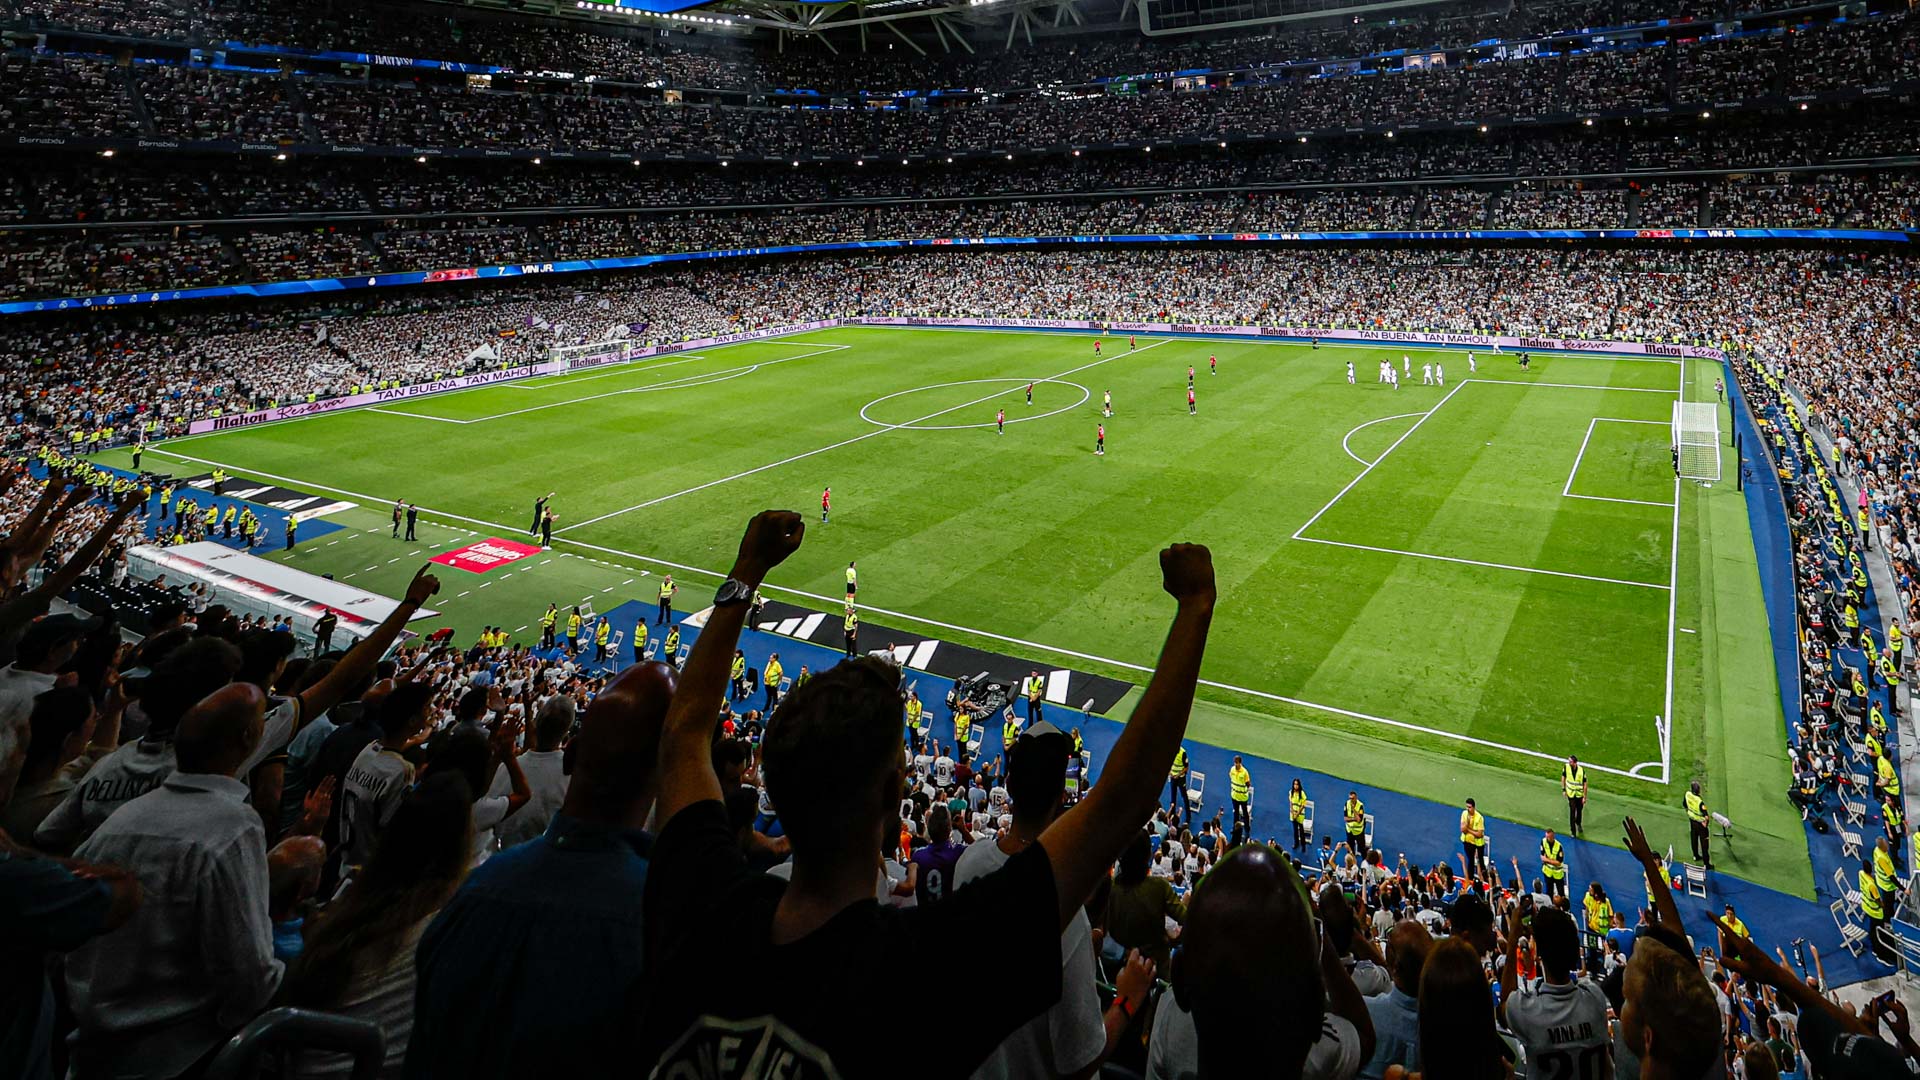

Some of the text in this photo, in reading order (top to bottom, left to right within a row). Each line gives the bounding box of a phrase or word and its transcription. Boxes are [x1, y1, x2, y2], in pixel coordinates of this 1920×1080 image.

[498, 266, 506, 275] 7
[521, 265, 539, 274] VINI
[1089, 321, 1111, 329] Mahu
[1170, 324, 1196, 333] Mahou
[713, 335, 730, 344] TAN
[765, 328, 781, 336] TAN
[1260, 327, 1288, 336] Mahou
[1358, 331, 1490, 345] TAN BUENA. TAN MAHOU.
[1519, 338, 1613, 350] Mahou Reserva
[656, 344, 683, 355] Mahou
[569, 356, 602, 368] Mahou
[376, 366, 540, 400] TAN BUENA. TAN MAHOU.
[213, 397, 346, 430] Mahou Reserva
[1812, 714, 1826, 725] 22
[926, 868, 943, 903] 9
